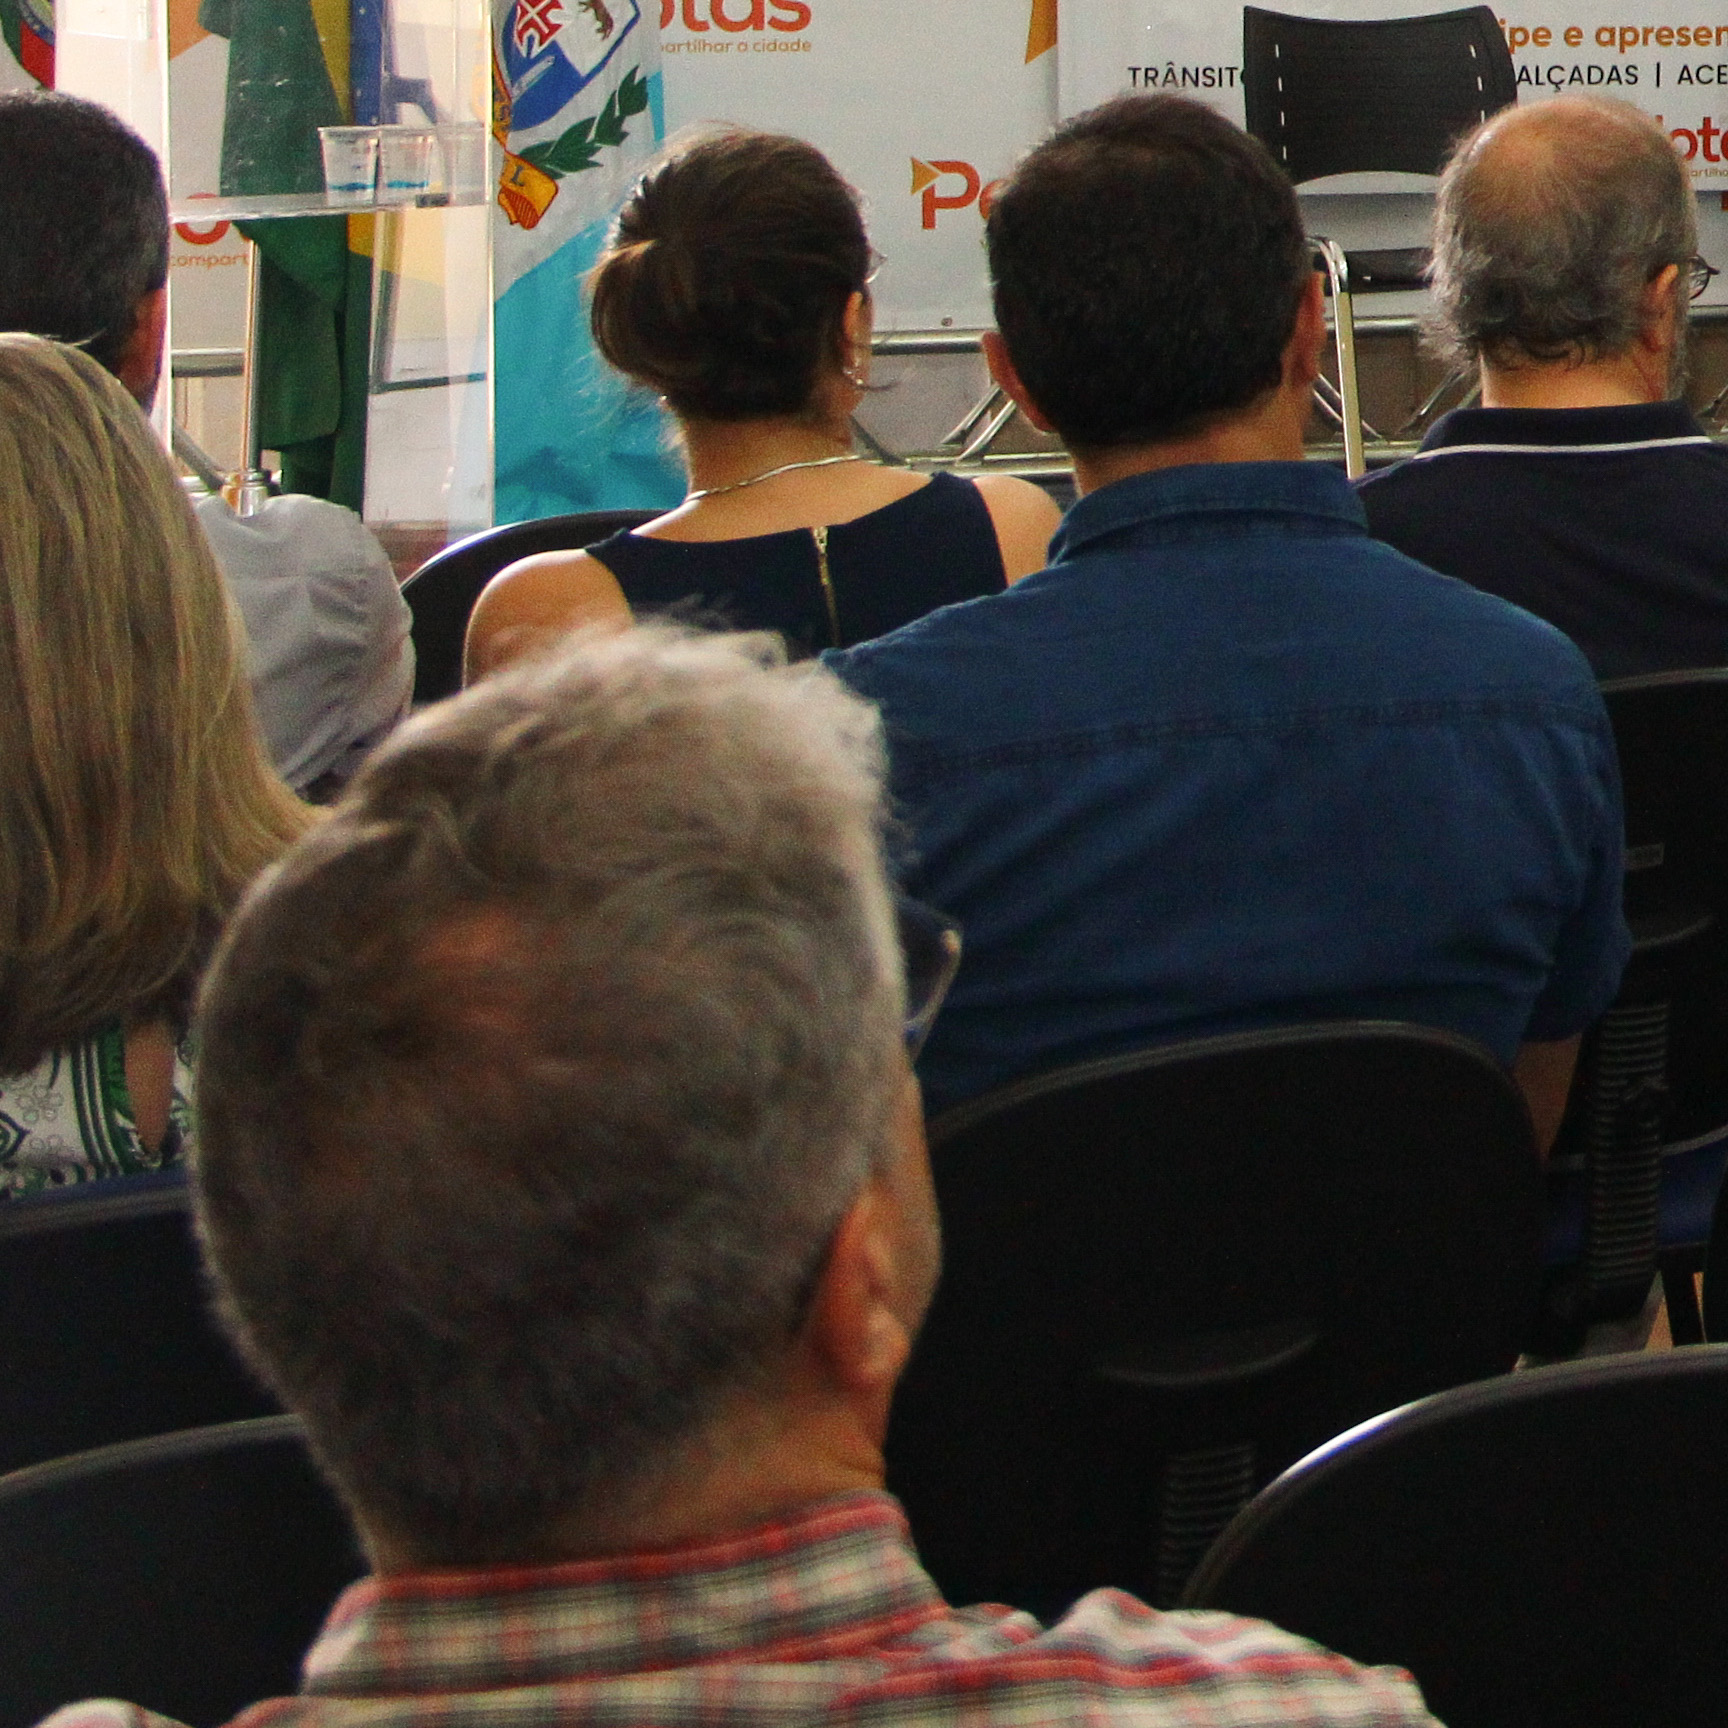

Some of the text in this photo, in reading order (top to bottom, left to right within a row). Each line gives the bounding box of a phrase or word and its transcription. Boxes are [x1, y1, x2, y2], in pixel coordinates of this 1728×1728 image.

[737, 42, 748, 53] a
[752, 38, 811, 53] cidade
[1563, 27, 1583, 48] e
[1128, 61, 1245, 89] TRÂNSIT
